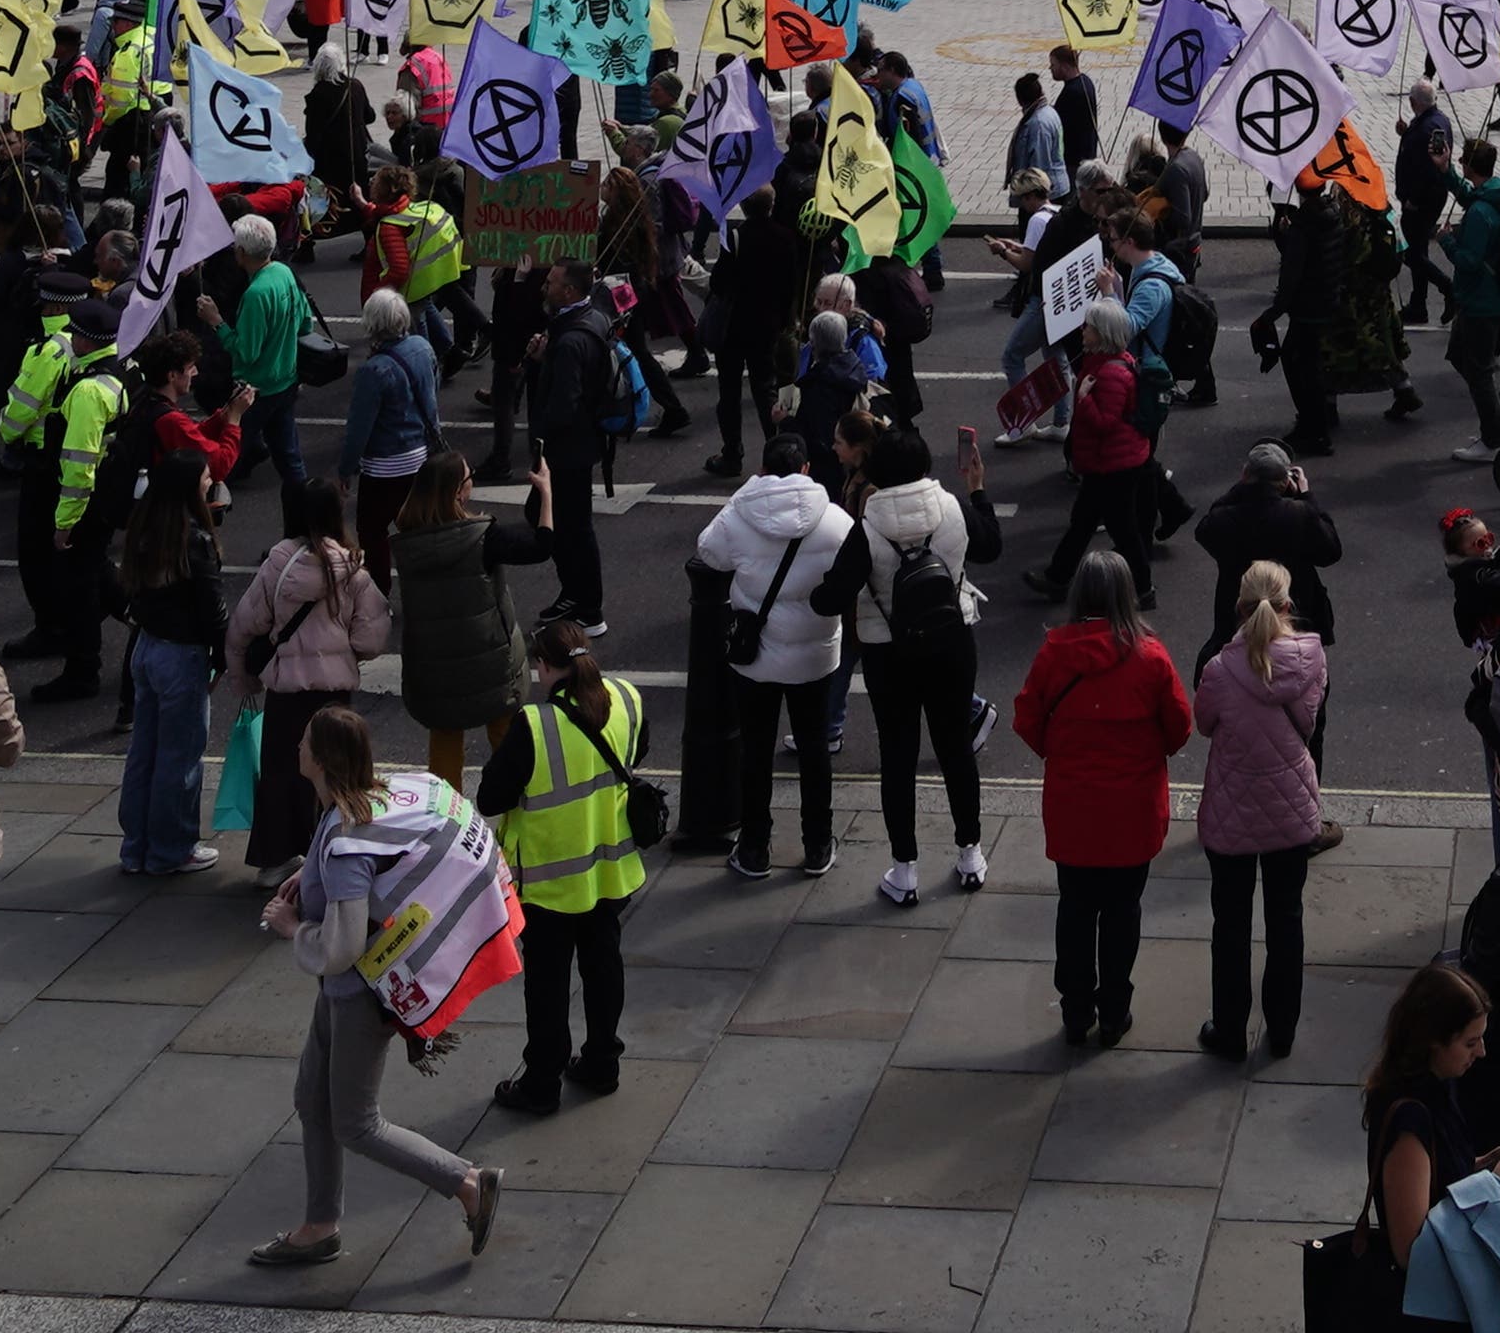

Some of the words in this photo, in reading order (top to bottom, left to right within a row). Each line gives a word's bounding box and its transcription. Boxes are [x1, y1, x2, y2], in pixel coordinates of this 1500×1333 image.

[476, 203, 516, 228] YOU
[521, 207, 568, 232] KNOW
[534, 233, 599, 263] TOXIC
[1065, 261, 1082, 300] EARTH
[1082, 252, 1097, 279] LIFE
[1051, 277, 1067, 317] DYING
